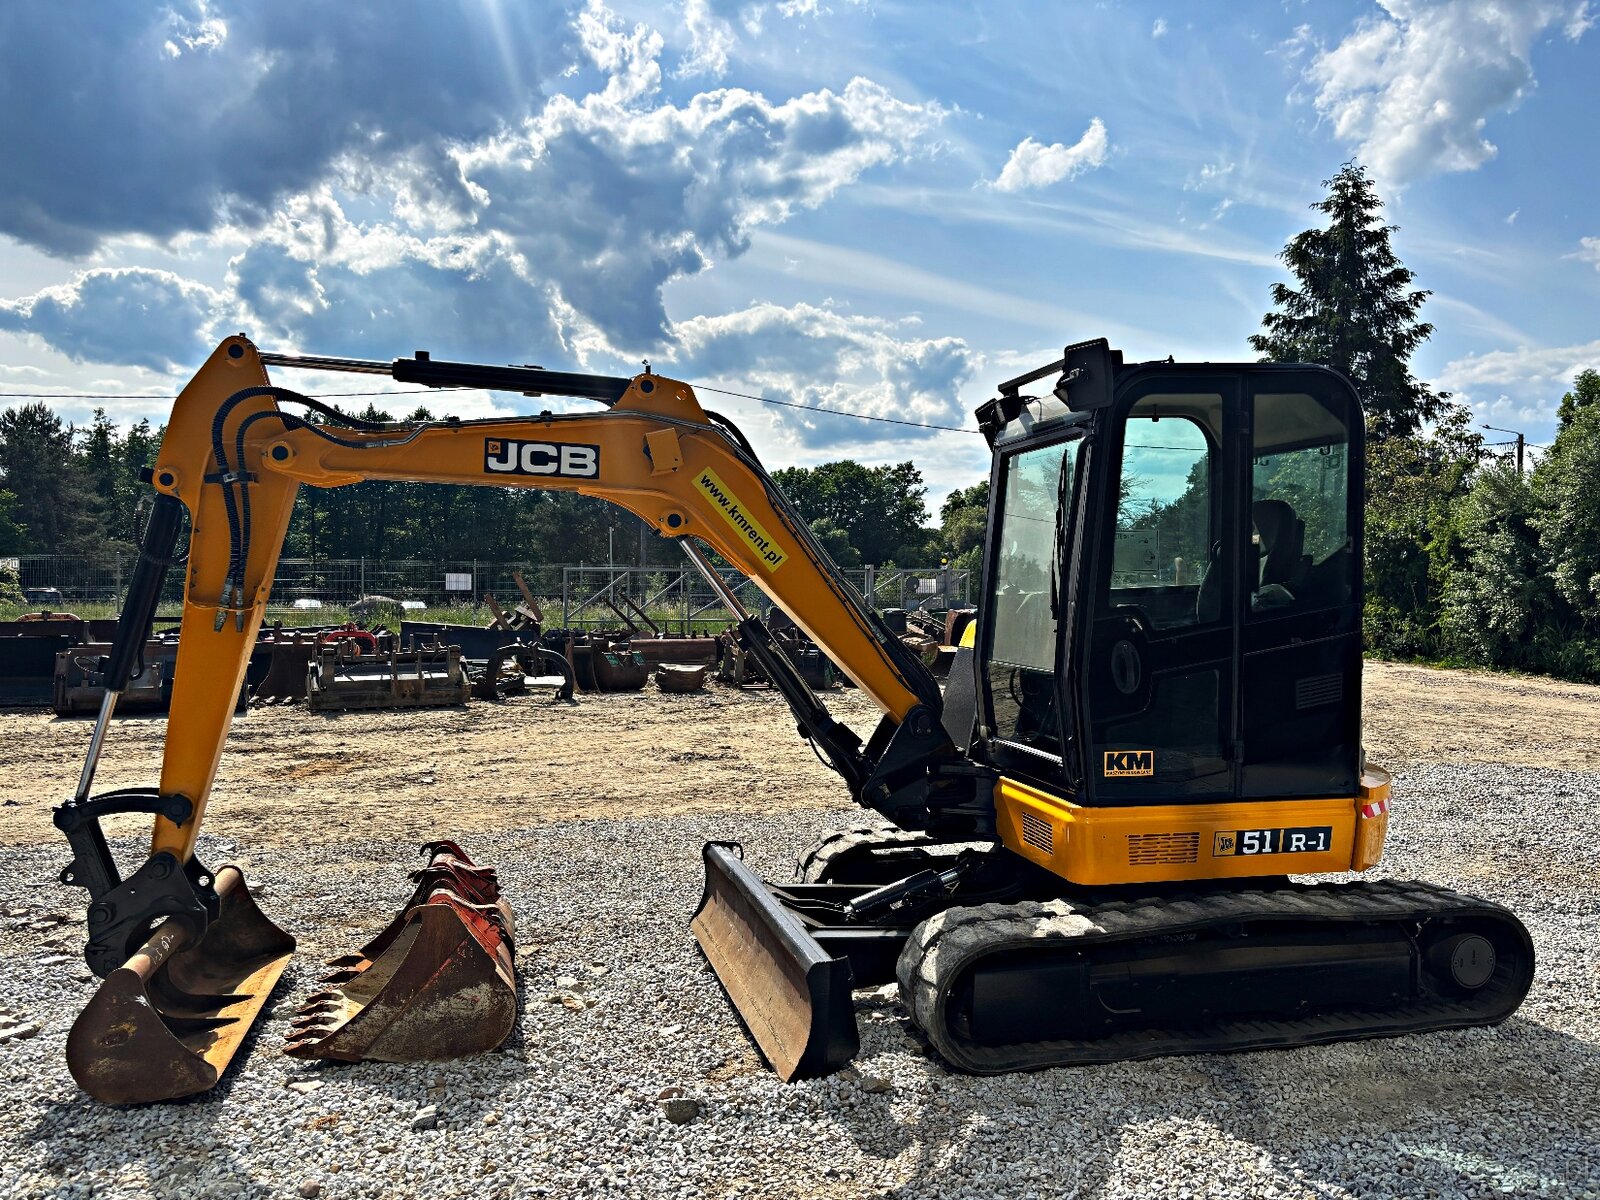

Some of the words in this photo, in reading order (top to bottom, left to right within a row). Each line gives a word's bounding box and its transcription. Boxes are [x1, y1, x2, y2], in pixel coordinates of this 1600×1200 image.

[487, 442, 597, 476] JCB
[700, 474, 783, 565] www.kmrent.pl
[1106, 752, 1151, 769] KM
[1242, 831, 1272, 854] 51
[1289, 832, 1325, 851] R-1
